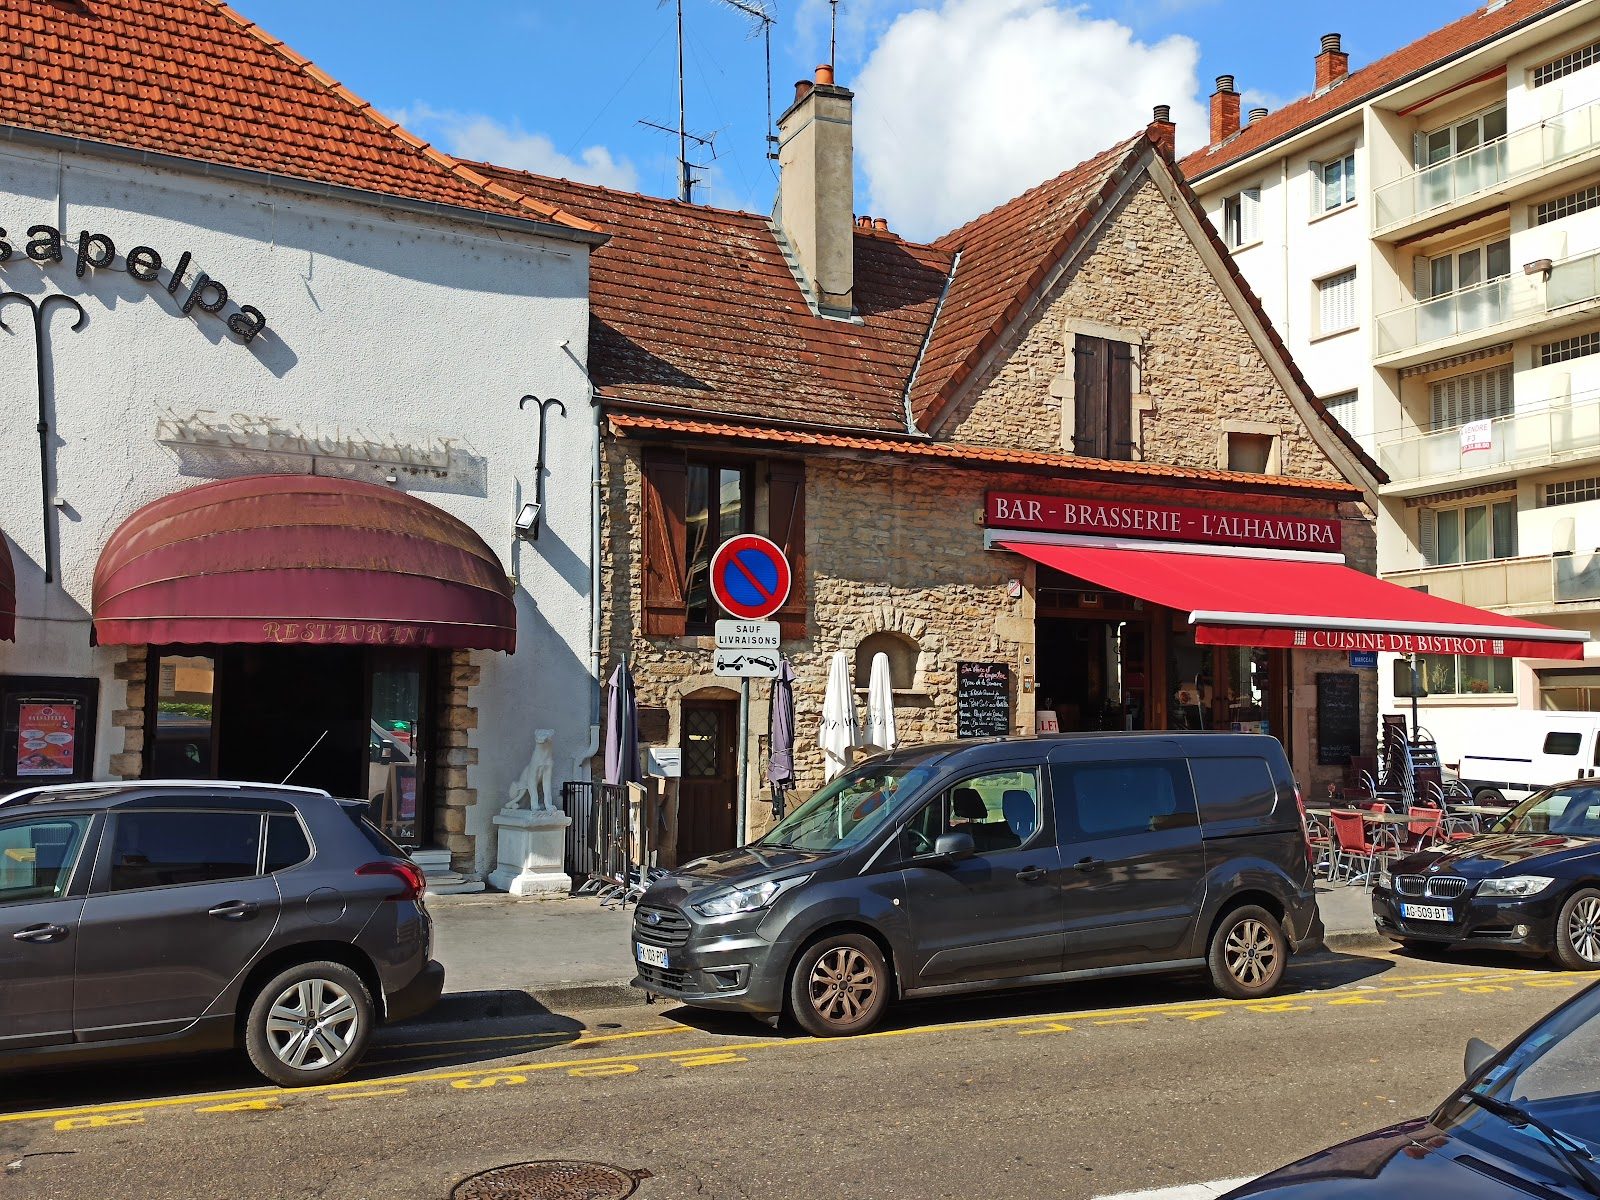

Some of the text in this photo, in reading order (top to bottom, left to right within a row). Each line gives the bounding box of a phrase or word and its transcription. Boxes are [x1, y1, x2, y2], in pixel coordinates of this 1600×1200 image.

[996, 498, 1043, 523] BAR
[1064, 503, 1182, 533] BRASSERIE
[1202, 514, 1336, 544] L'ALHAMBRA
[262, 621, 433, 644] RESTAURANT
[719, 636, 777, 644] LIVRAISONS
[736, 625, 761, 633] SAUF
[1313, 631, 1487, 654] CUISINE DE BISTROT
